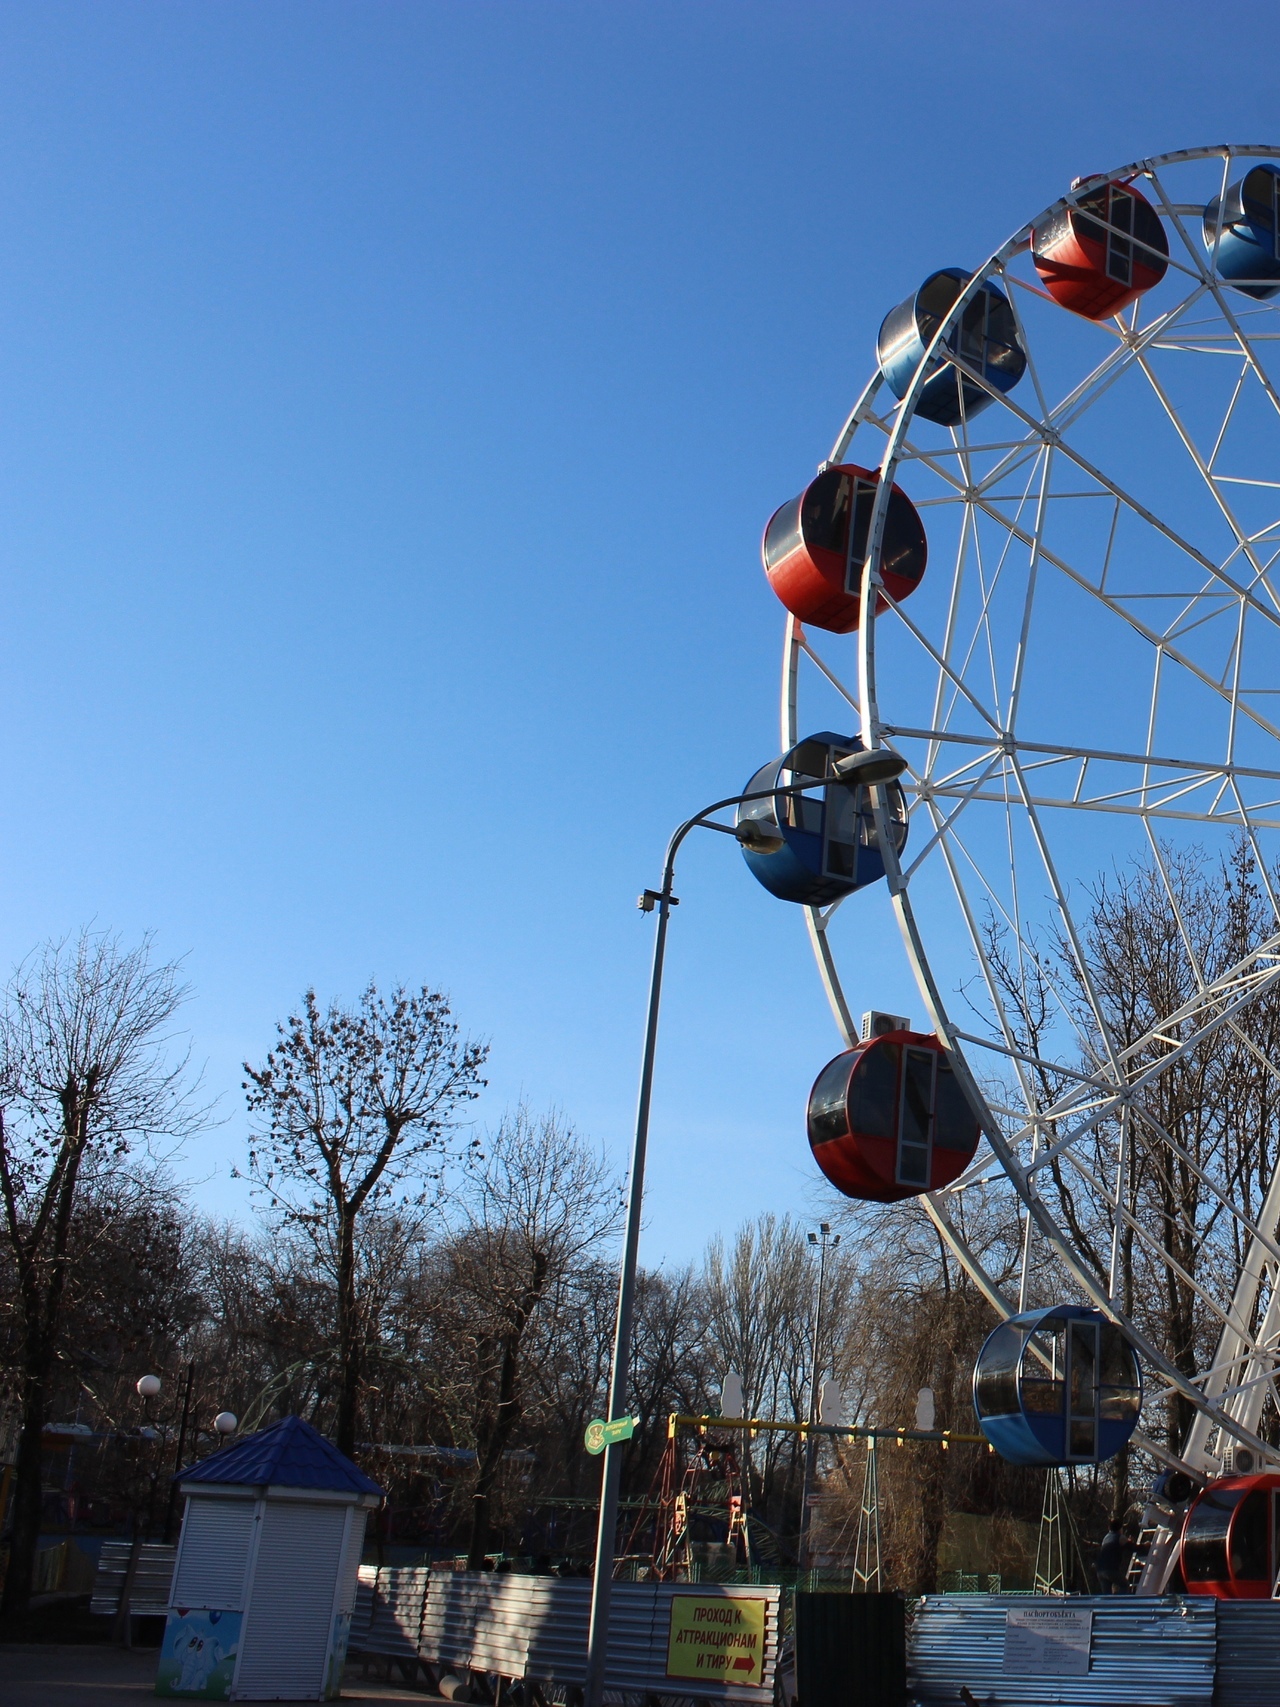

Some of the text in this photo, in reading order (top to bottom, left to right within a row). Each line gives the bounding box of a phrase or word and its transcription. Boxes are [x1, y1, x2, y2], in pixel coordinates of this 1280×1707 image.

[693, 1607, 743, 1626] ПРОХОД К
[675, 1629, 757, 1649] АТТРАКЦИОНАМ
[696, 1653, 733, 1670] И ТИРУ
